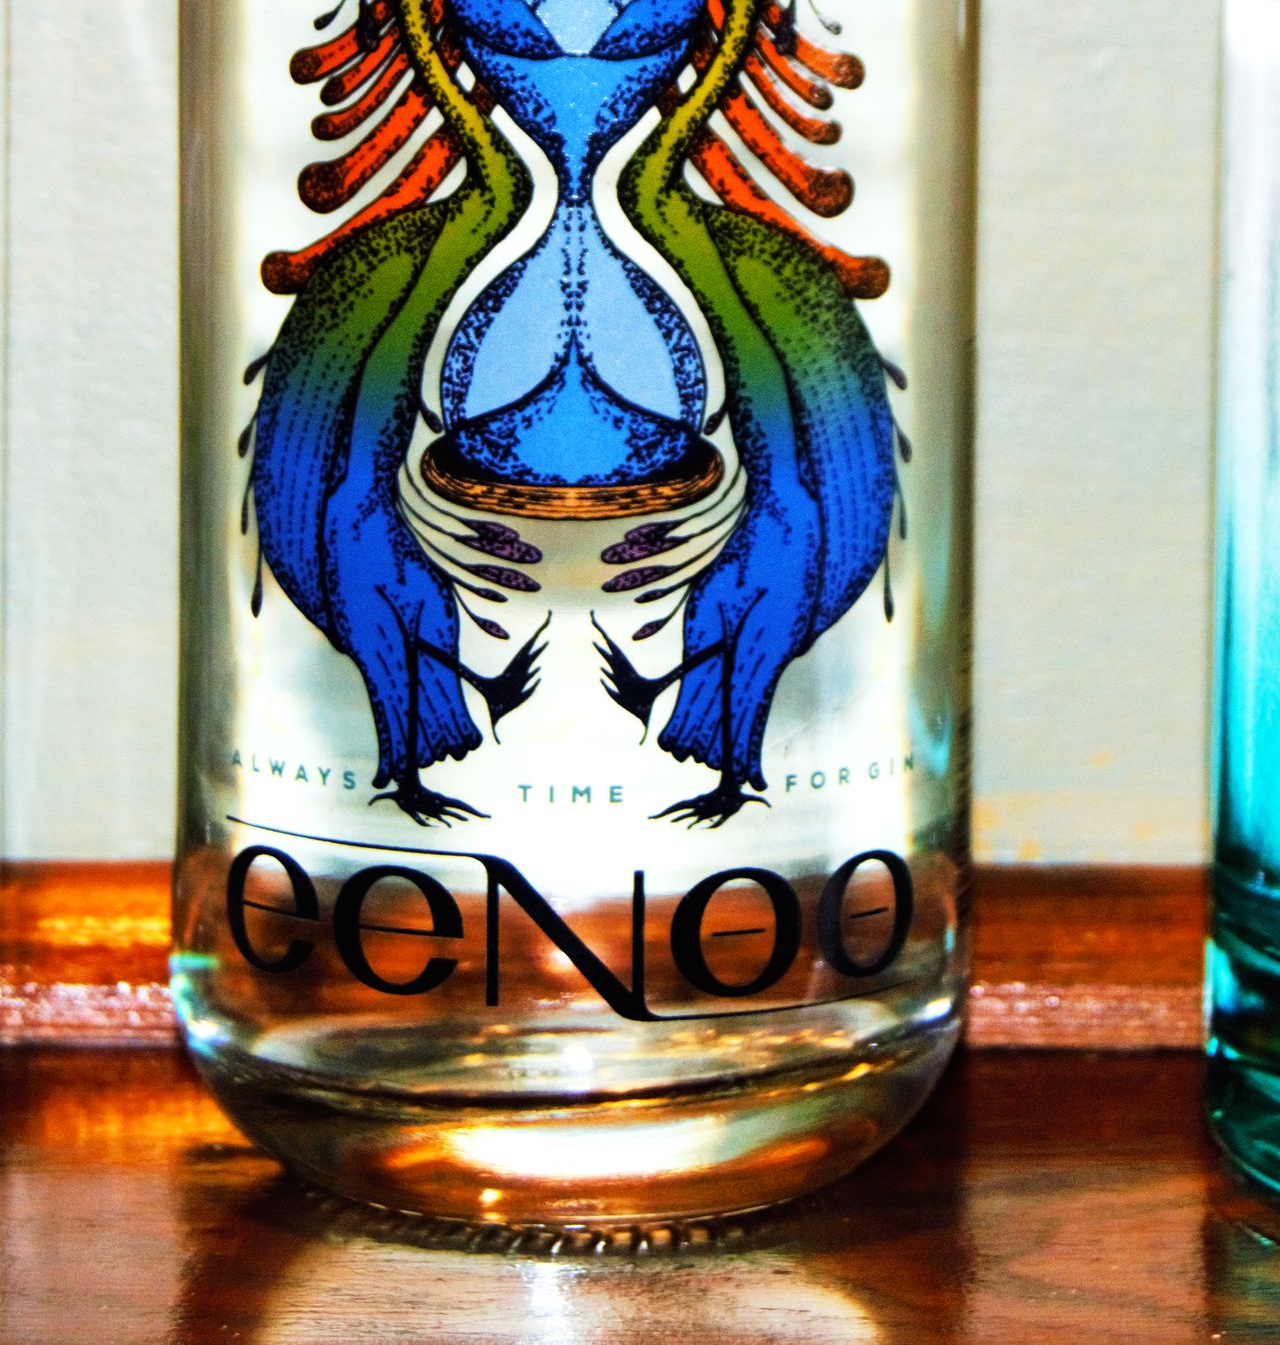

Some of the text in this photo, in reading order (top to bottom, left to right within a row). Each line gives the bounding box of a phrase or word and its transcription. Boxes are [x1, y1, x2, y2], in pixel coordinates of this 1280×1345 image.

[231, 748, 914, 804] ALWAYS TIME FOR GIN
